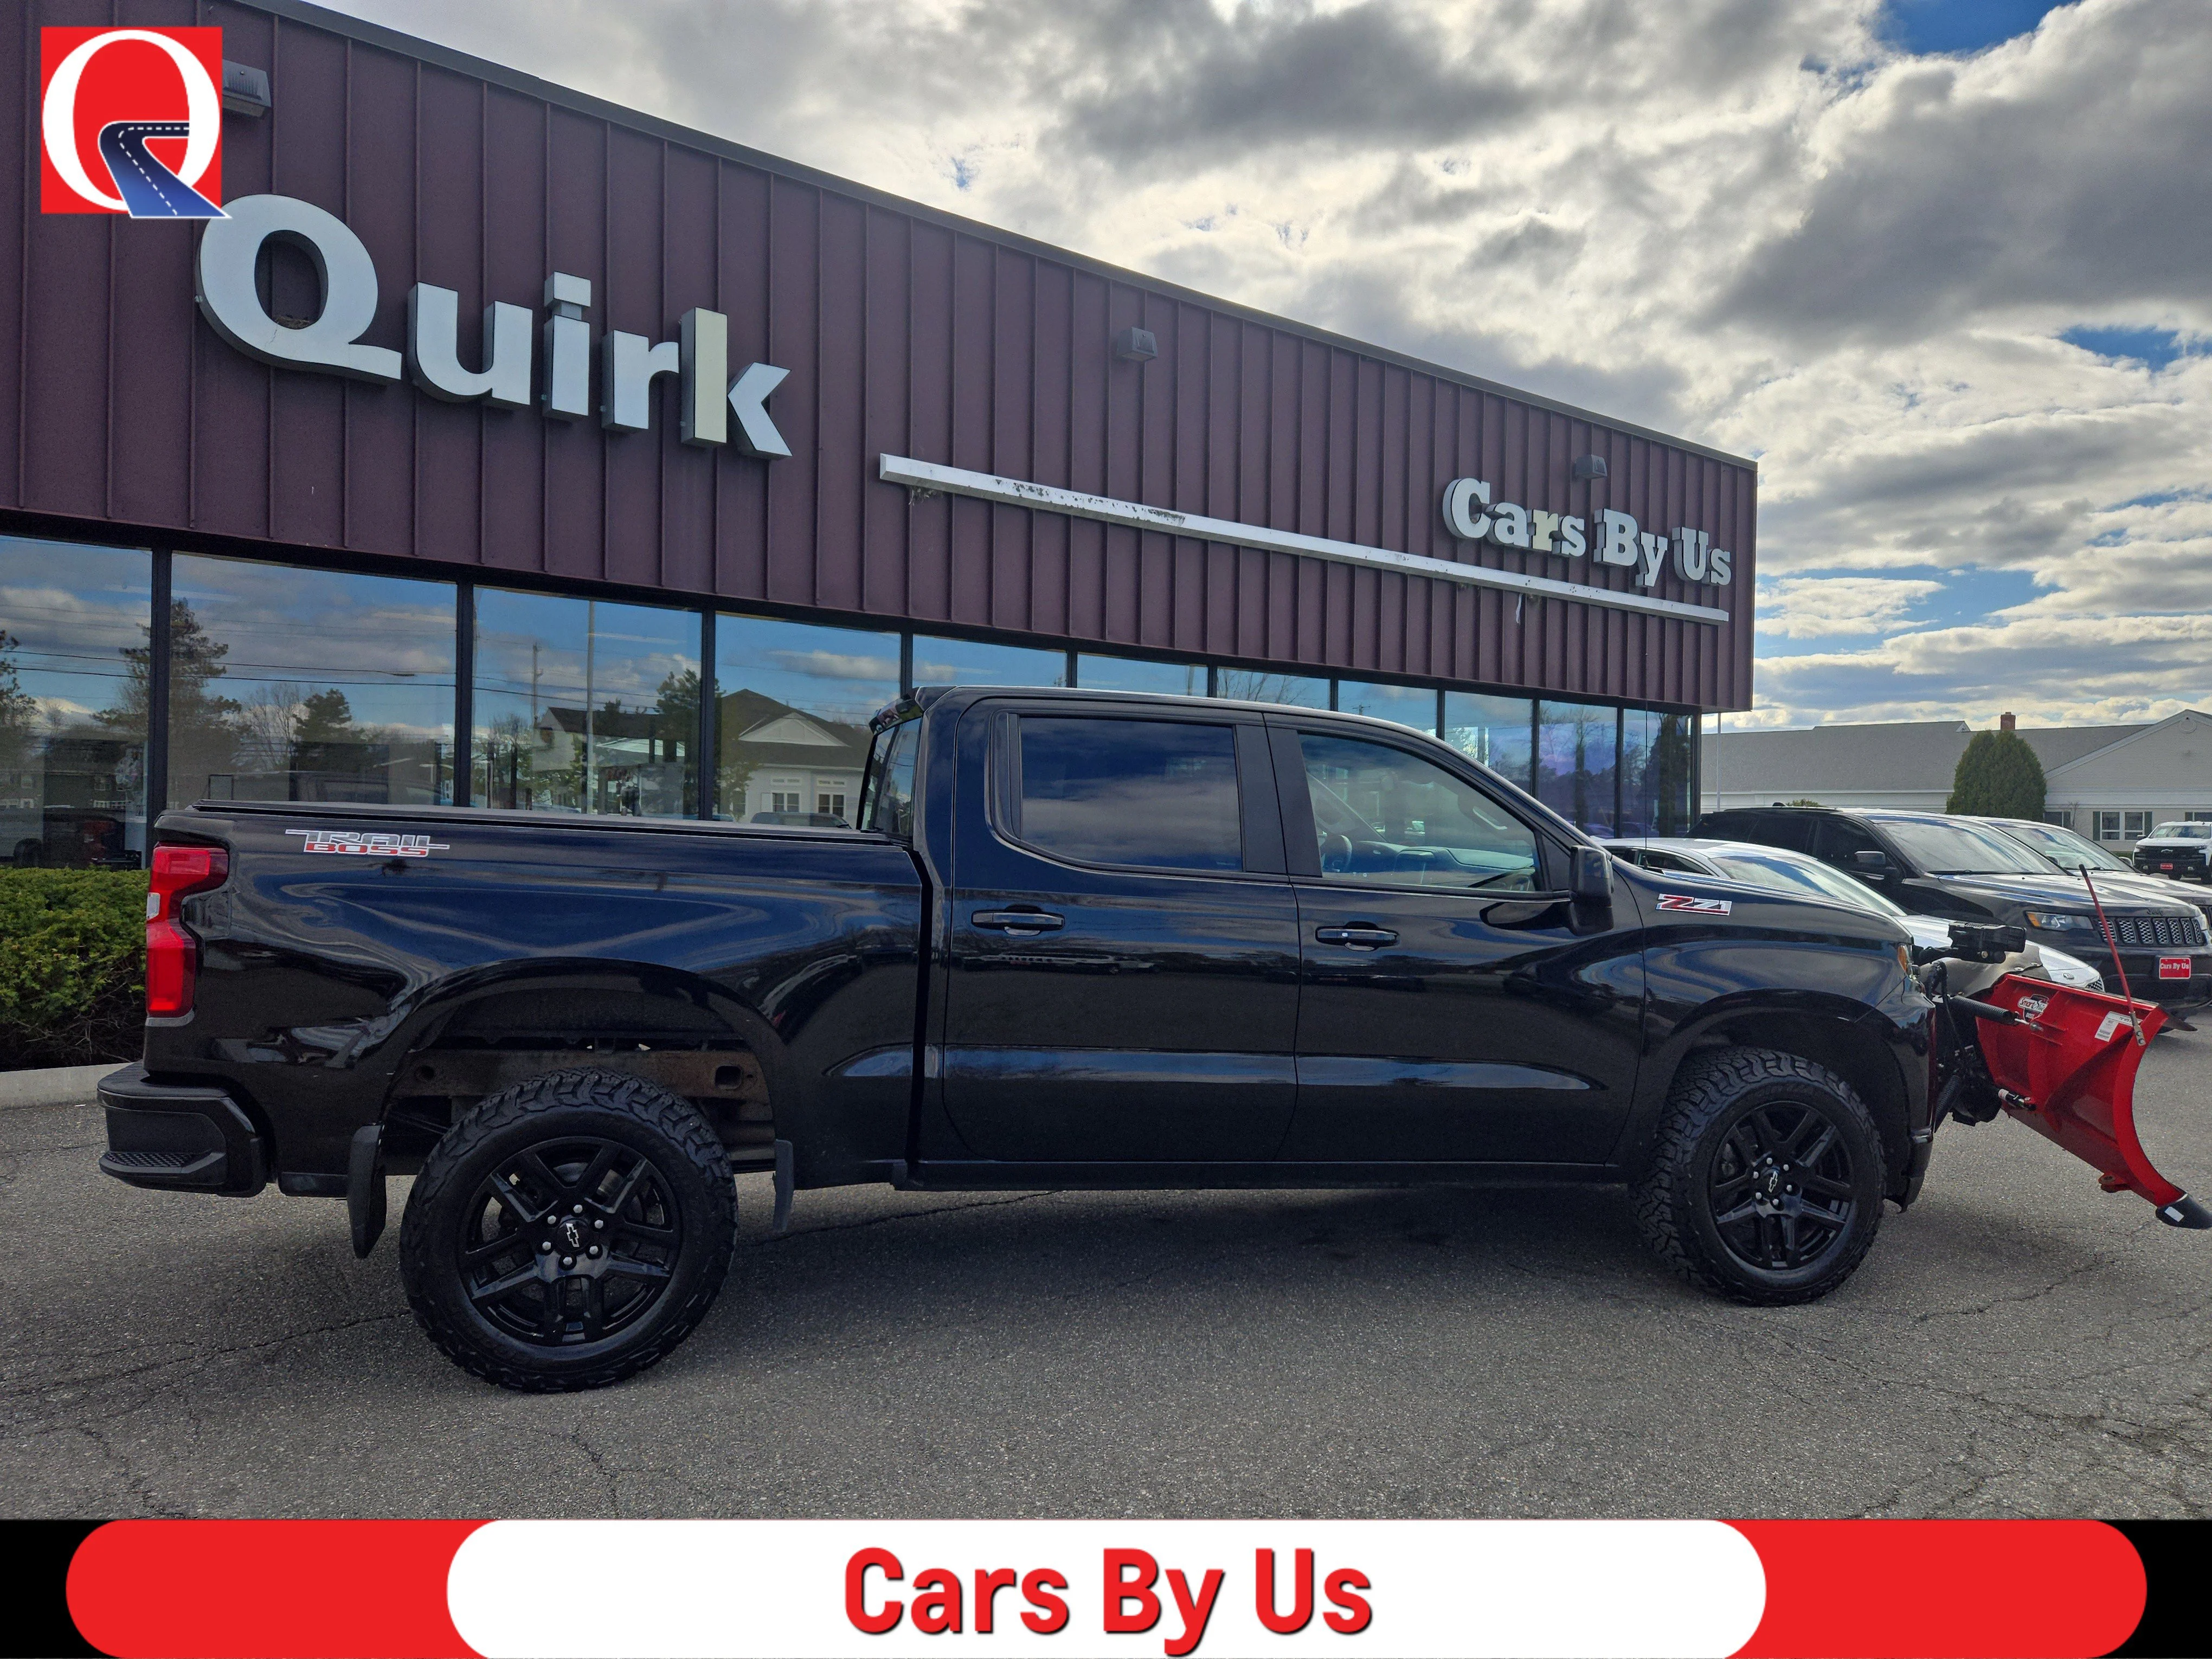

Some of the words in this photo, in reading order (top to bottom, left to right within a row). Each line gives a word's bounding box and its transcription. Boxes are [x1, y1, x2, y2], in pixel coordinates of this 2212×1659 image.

[195, 194, 793, 460] Quirk
[1443, 478, 1586, 557] Cars
[1593, 509, 1668, 587] By
[1672, 527, 1731, 586] Us
[285, 829, 450, 850] TRAIL
[304, 841, 429, 857] BOSS
[1656, 893, 1732, 916] Z71
